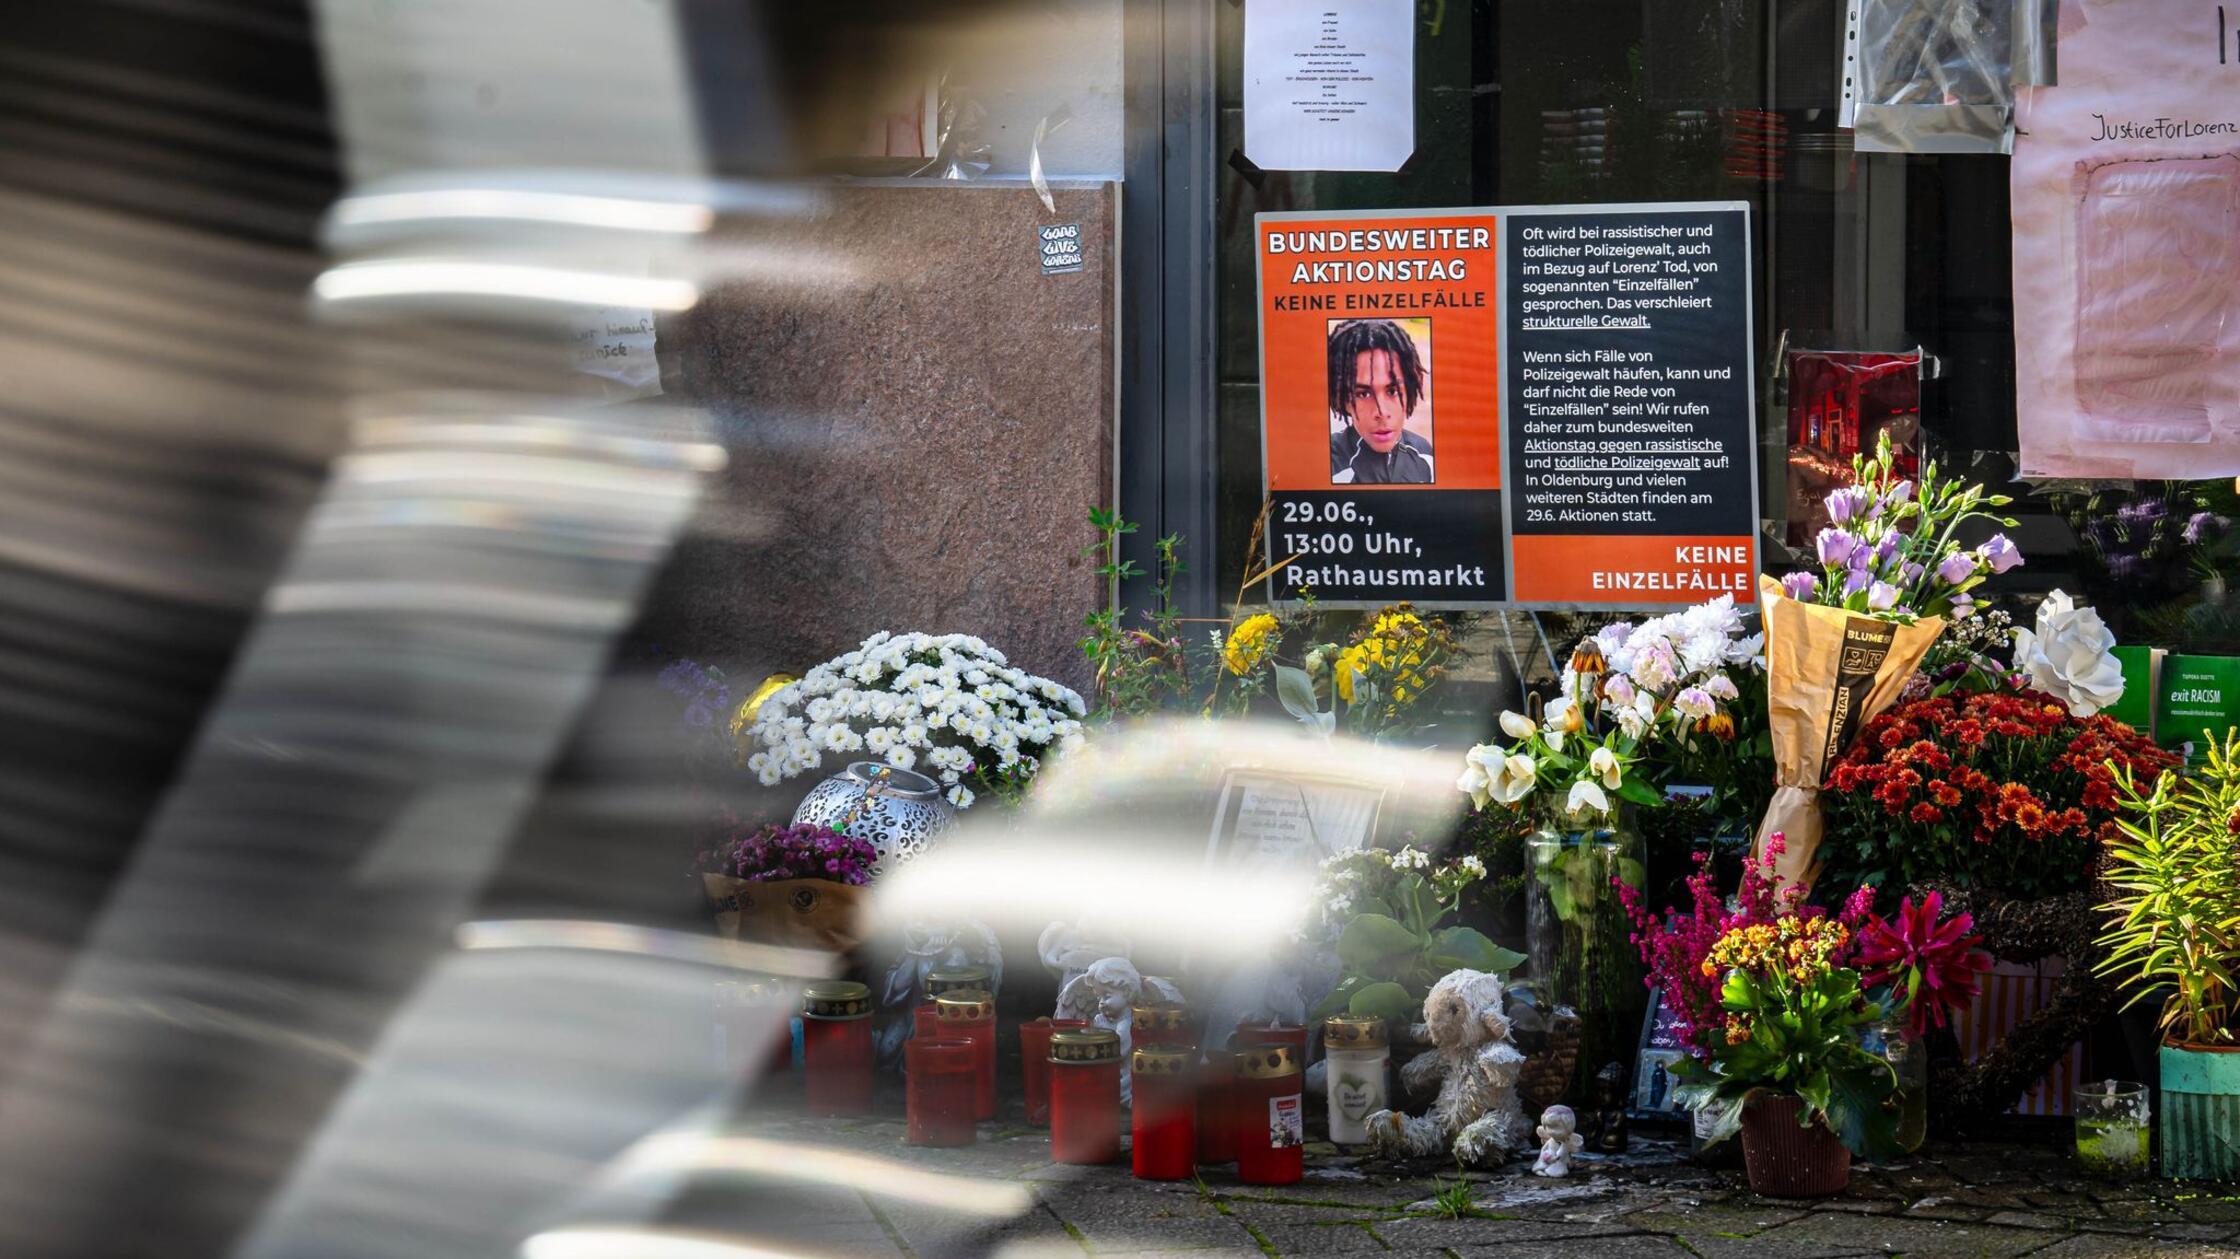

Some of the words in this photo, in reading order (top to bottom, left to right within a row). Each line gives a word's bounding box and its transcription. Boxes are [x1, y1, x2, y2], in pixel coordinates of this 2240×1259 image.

[1523, 228, 1544, 240] Oft
[1547, 227, 1576, 239] wird
[1580, 226, 1599, 239] bei
[1603, 225, 1682, 239] rassistischer
[1687, 224, 1713, 237] und
[1268, 228, 1490, 254] BUNDESWEITER
[1523, 245, 1580, 258] tödlicher
[1585, 243, 1675, 259] Polizeigewalt,
[1678, 242, 1711, 255] auch
[1291, 259, 1466, 284] AKTIONSTAG
[1523, 263, 1540, 275] im
[1544, 263, 1585, 277] Bezug
[1588, 262, 1611, 275] auf
[1663, 261, 1690, 275] Tod,
[1693, 262, 1718, 273] von
[1523, 281, 1609, 295] sogenannten
[1275, 295, 1337, 311] KEINE
[1346, 289, 1485, 310] EINZELFÄLLE
[1523, 299, 1603, 313] gesprochen.
[1608, 298, 1632, 310] Das
[1635, 296, 1712, 309] verschleiert
[1523, 316, 1598, 328] strukturelle
[1601, 315, 1651, 328] Gewalt.
[1523, 351, 1562, 363] Wenn
[1565, 350, 1591, 363] sich
[1595, 350, 1626, 363] Fälle
[1628, 351, 1653, 362] von
[1524, 368, 1610, 382] Polizeigewalt
[1614, 367, 1664, 381] häufen,
[1667, 367, 1700, 380] kann
[1704, 366, 1731, 379] und
[1523, 385, 1552, 398] darf
[1554, 385, 1586, 398] nicht
[1590, 385, 1610, 398] die
[1614, 386, 1648, 398] Rede
[1651, 387, 1676, 397] von
[1612, 403, 1643, 416] sein!
[1646, 403, 1670, 415] Wir
[1674, 402, 1710, 415] rufen
[1524, 420, 1563, 433] daher
[1566, 423, 1595, 433] zum
[1598, 420, 1694, 433] bundesweiten
[1525, 439, 1596, 453] Aktionstag
[1600, 441, 1642, 453] gegen
[1645, 438, 1723, 451] rassistische
[1526, 456, 1551, 468] und
[1554, 456, 1608, 468] tödliche
[1612, 456, 1701, 471] Polizeigewalt
[1704, 456, 1729, 468] auf!
[1526, 474, 1538, 486] In
[1542, 474, 1613, 489] Oldenburg
[1616, 474, 1643, 486] und
[1646, 473, 1687, 486] vielen
[1526, 491, 1584, 504] weiteren
[1587, 491, 1639, 504] Städten
[1642, 491, 1687, 504] finden
[1690, 493, 1712, 504] am
[1283, 502, 1374, 526] 29.06.,
[1526, 509, 1556, 522] 29.6.
[1559, 509, 1619, 522] Aktionen
[1622, 509, 1656, 522] statt.
[1284, 533, 1354, 555] 13:00
[1365, 533, 1422, 558] Uhr,
[1676, 546, 1748, 564] KEINE
[1287, 564, 1485, 586] Rathausmarkt
[1593, 570, 1748, 590] EINZELFÄLLE
[2171, 689, 2190, 702] exit
[2191, 689, 2221, 703] RACISM
